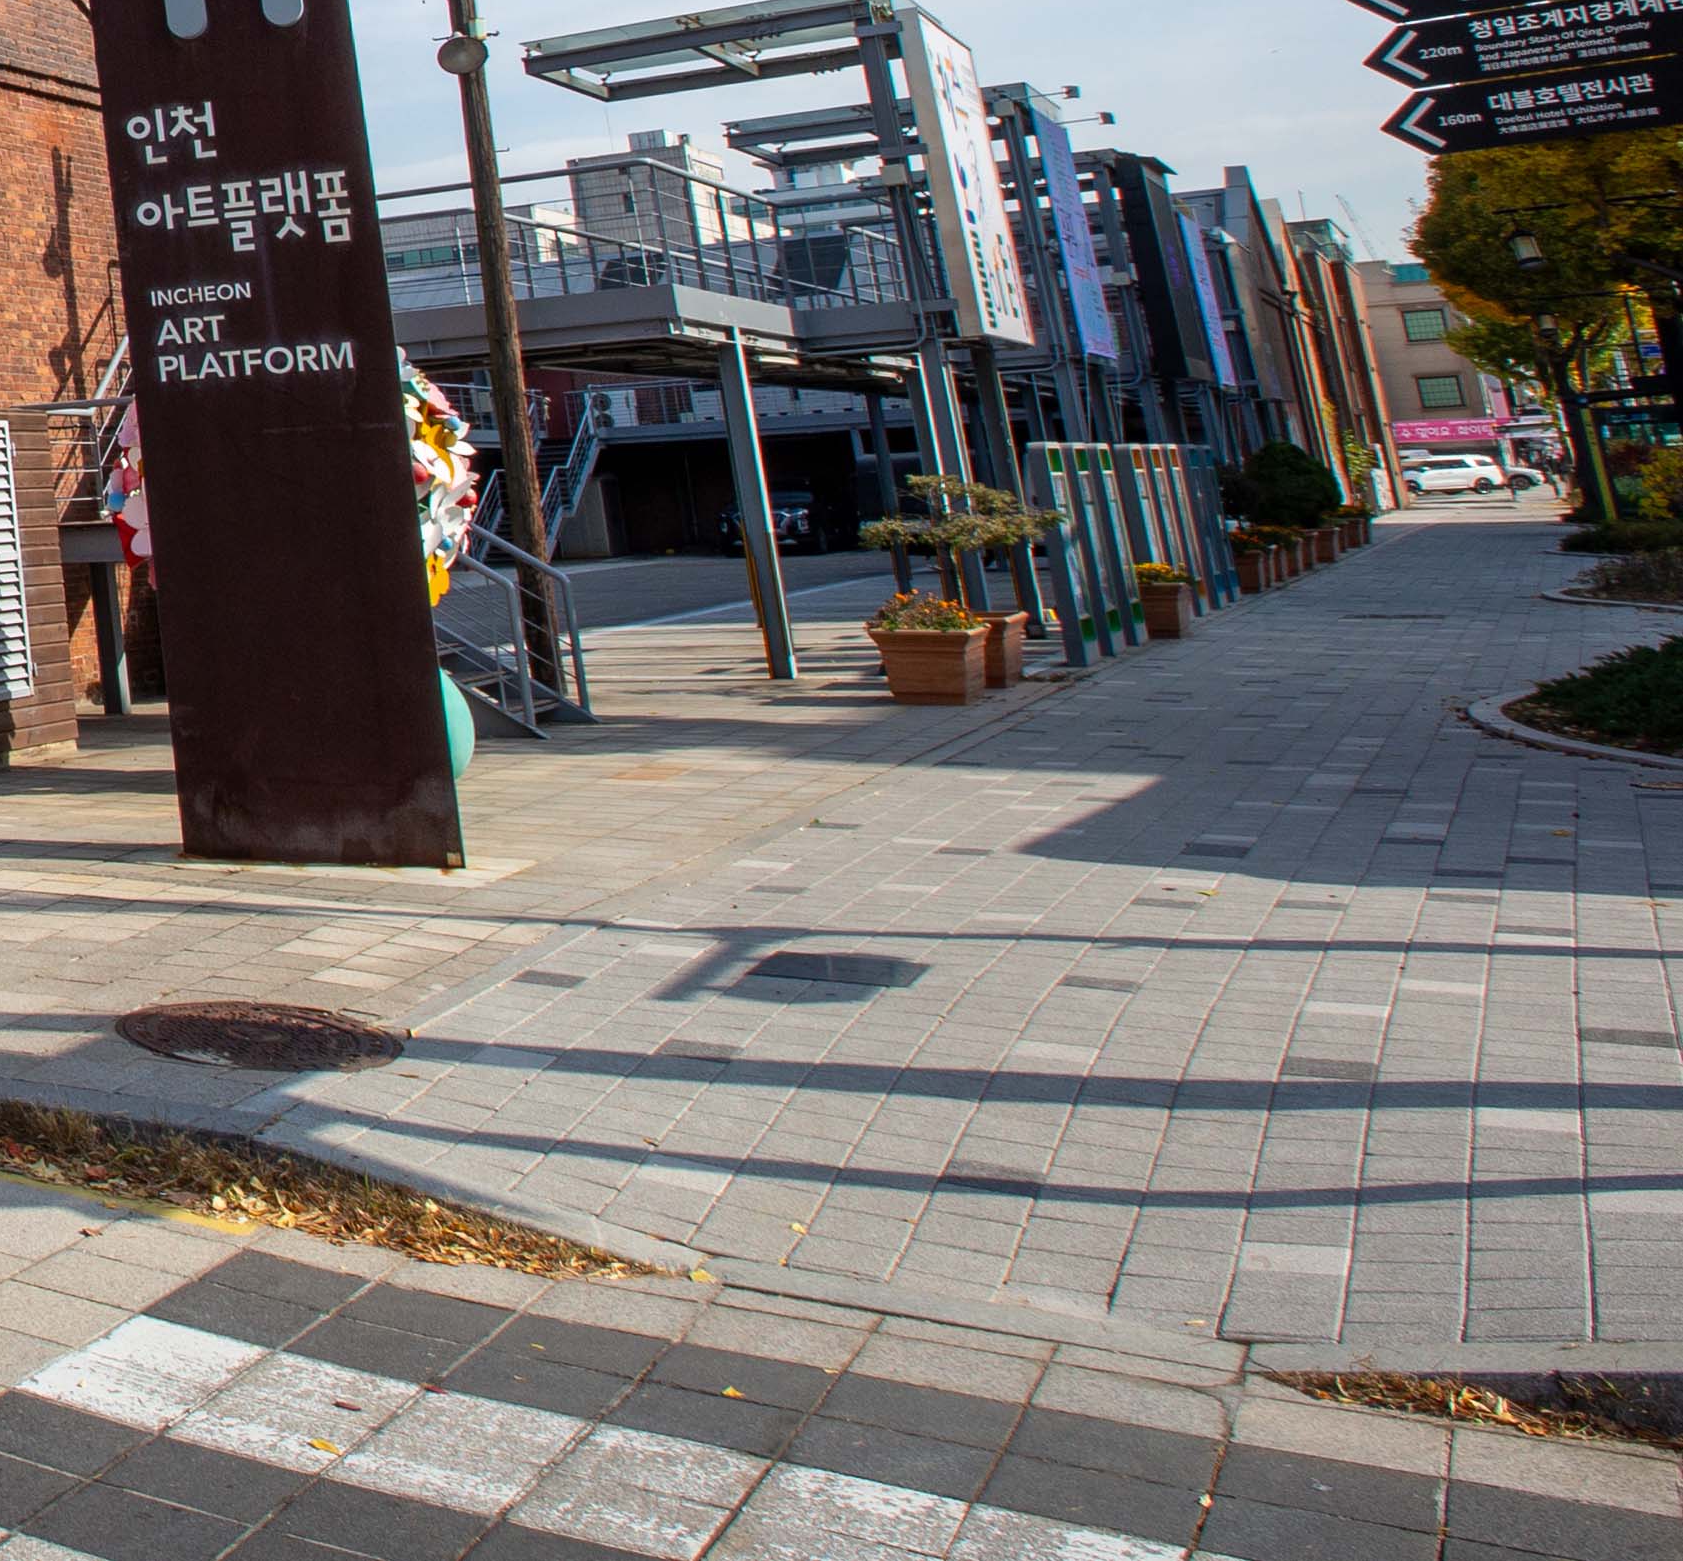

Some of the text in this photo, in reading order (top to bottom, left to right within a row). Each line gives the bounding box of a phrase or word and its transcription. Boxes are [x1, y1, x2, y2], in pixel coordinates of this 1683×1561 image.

[1419, 44, 1464, 60] 220m
[1474, 20, 1651, 53] Boundary Stairs Of Qing Dynasty
[1478, 52, 1501, 62] And
[1502, 44, 1553, 60] Japanese
[1554, 36, 1617, 52] Settlement
[1486, 72, 1654, 111] 대불호텔전시관
[1438, 111, 1483, 127] 160m
[1495, 101, 1624, 125] Daebul Hotel Exhibition
[126, 101, 217, 165] 인천
[136, 170, 352, 252] 아트플랫폼
[150, 282, 252, 307] INCHEON
[157, 314, 226, 346] ART
[157, 341, 355, 383] PLATFORM
